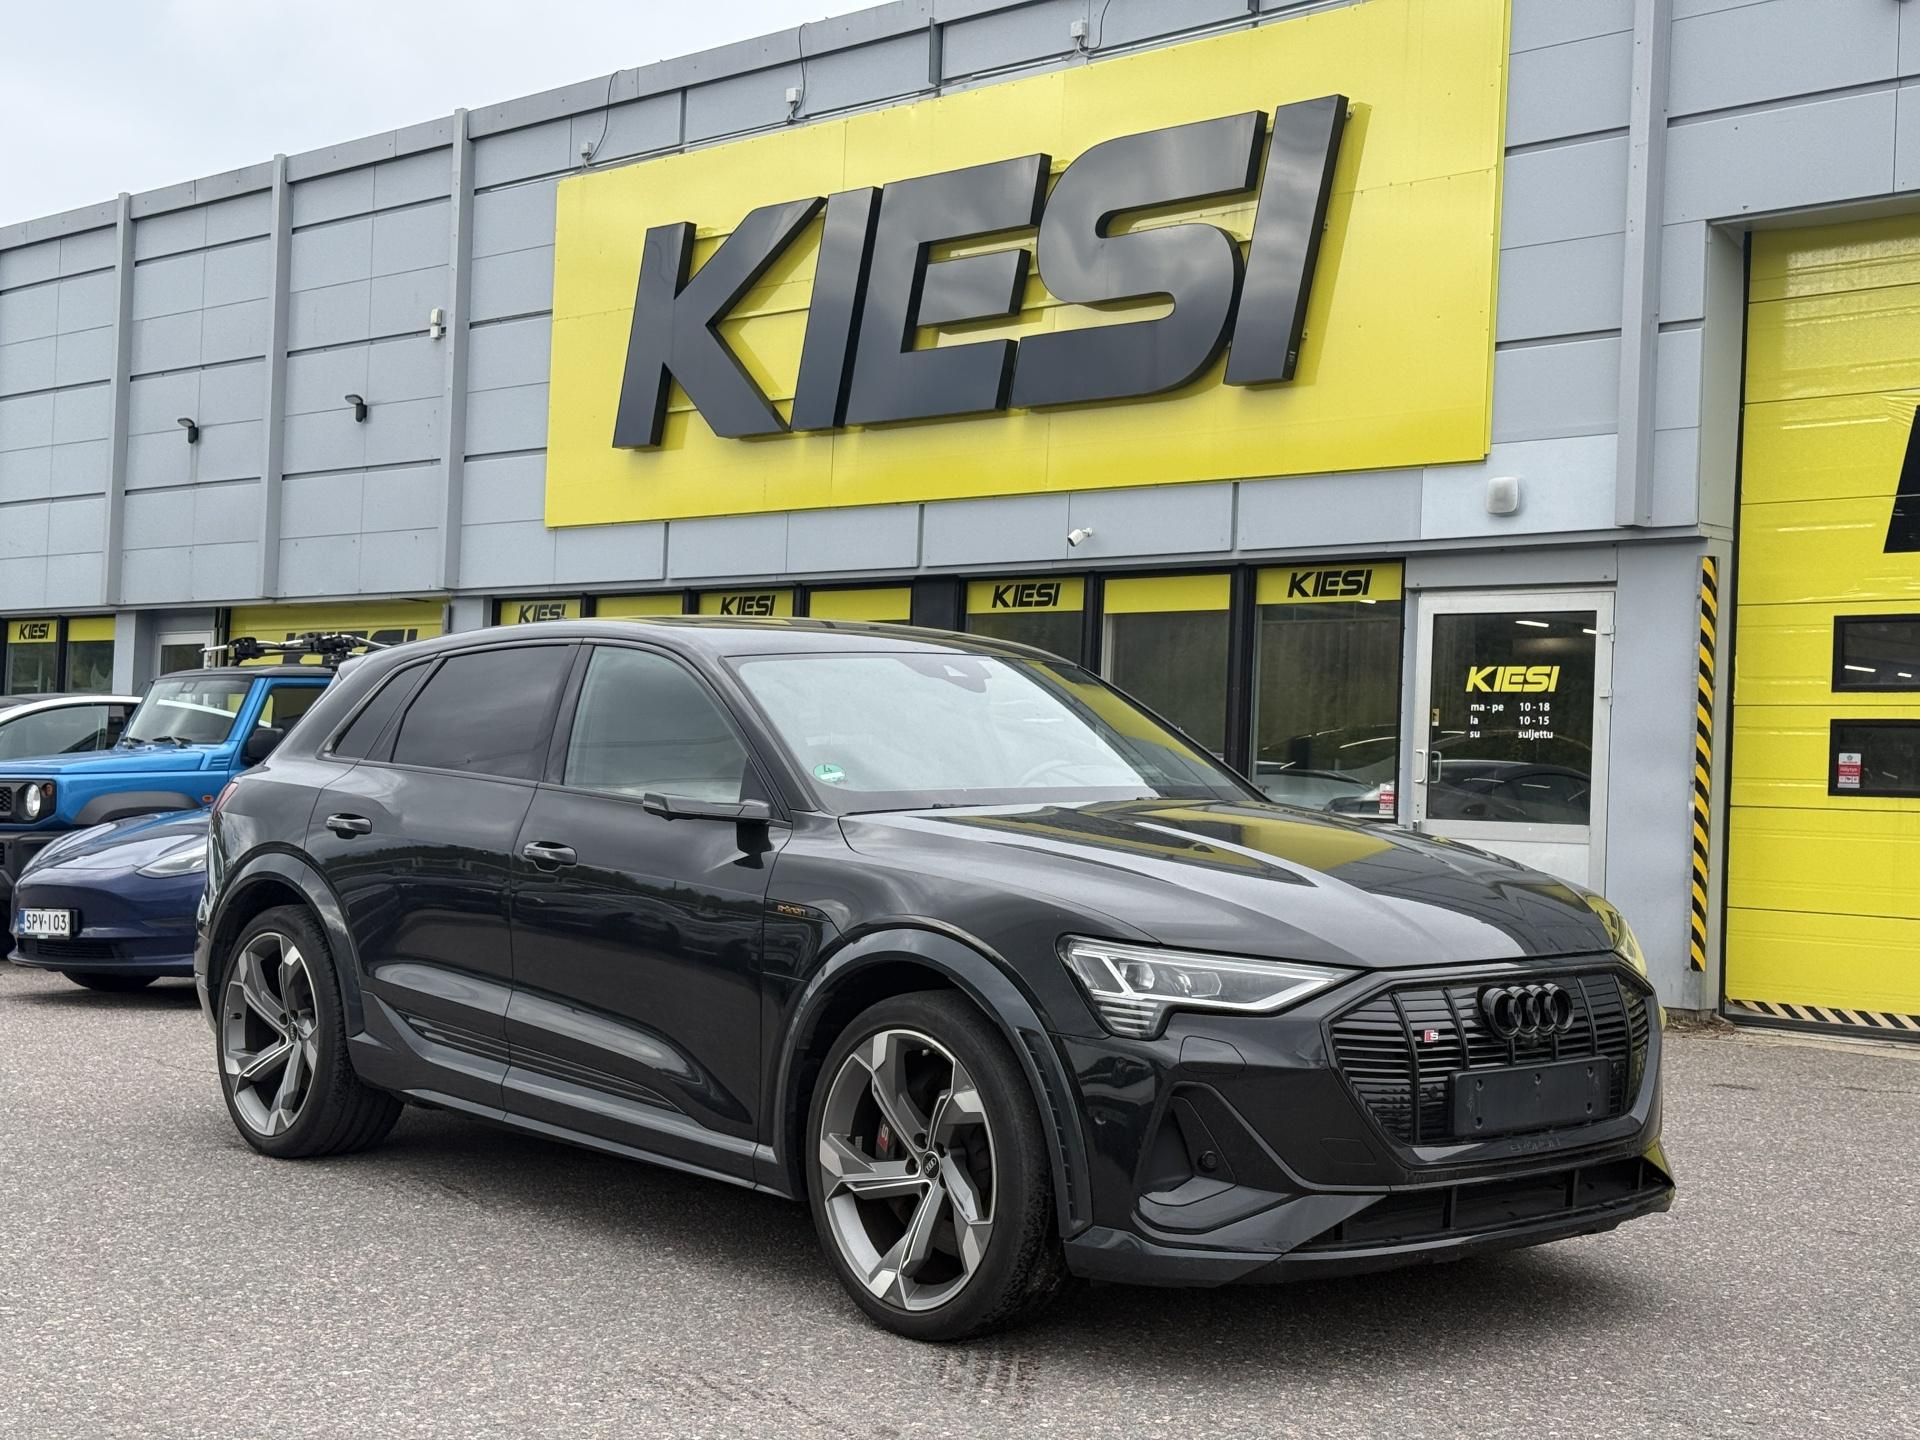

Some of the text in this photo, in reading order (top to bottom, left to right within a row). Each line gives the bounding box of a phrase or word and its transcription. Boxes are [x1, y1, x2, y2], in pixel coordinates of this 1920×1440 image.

[612, 93, 1349, 450] KIESI
[1286, 569, 1373, 598] KIESI
[720, 595, 776, 616] KIESI
[991, 583, 1062, 609] KIESI
[518, 603, 567, 624] KIESI
[19, 623, 50, 640] KIESI
[1465, 665, 1560, 693] KIESI
[1470, 703, 1485, 711] ma
[1491, 703, 1504, 714] pe
[1519, 702, 1531, 711] 10
[1538, 702, 1550, 711] 18
[1469, 715, 1479, 725] la
[1518, 716, 1531, 725] 10
[1538, 716, 1550, 725] 15
[1469, 729, 1554, 741] su suljettu
[26, 913, 67, 931] SPV-103
